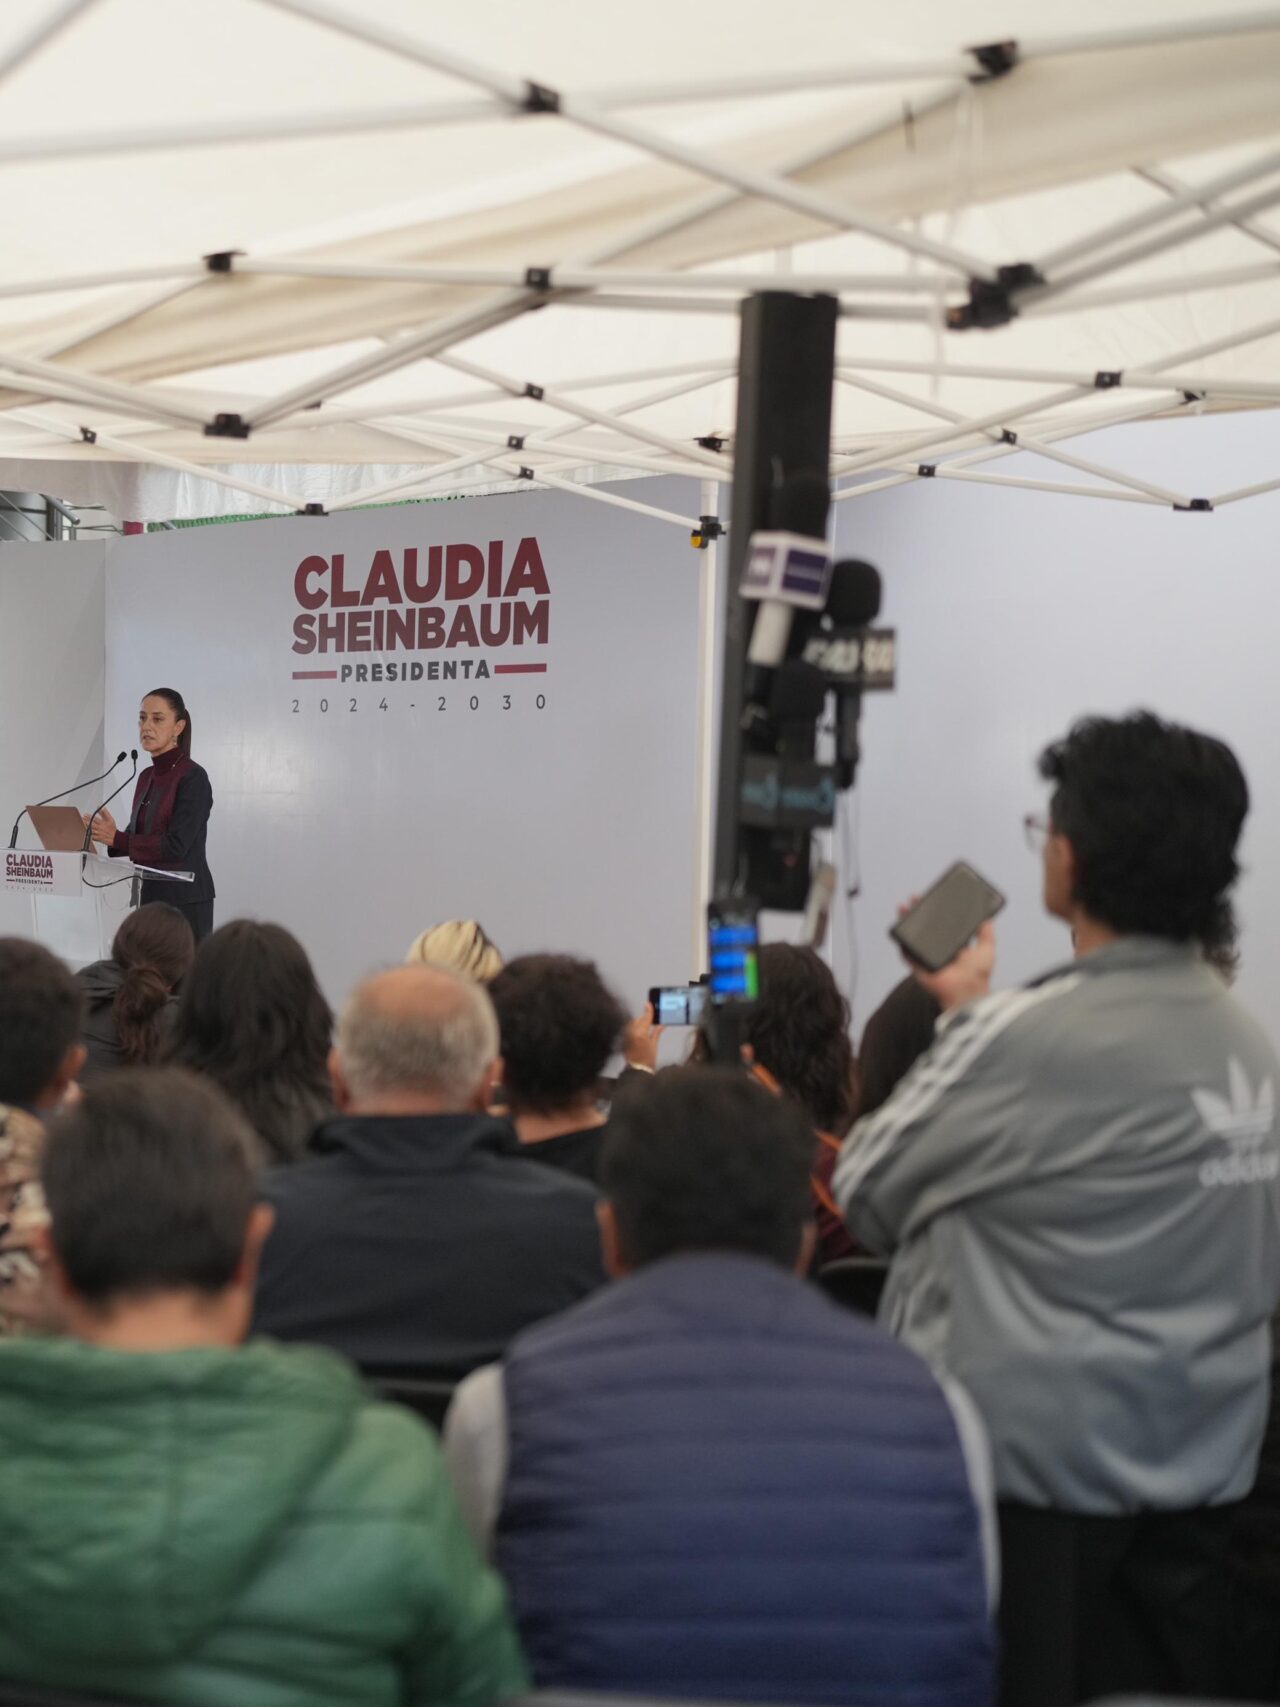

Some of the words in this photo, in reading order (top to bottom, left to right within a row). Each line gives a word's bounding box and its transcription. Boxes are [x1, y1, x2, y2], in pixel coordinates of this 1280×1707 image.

[294, 537, 551, 610] CLAUDIA
[291, 600, 550, 655] SHEINBAUM
[341, 660, 491, 683] PRESIDENTA
[6, 854, 53, 869] CLAUDIA
[6, 866, 54, 879] SHEINBAUM
